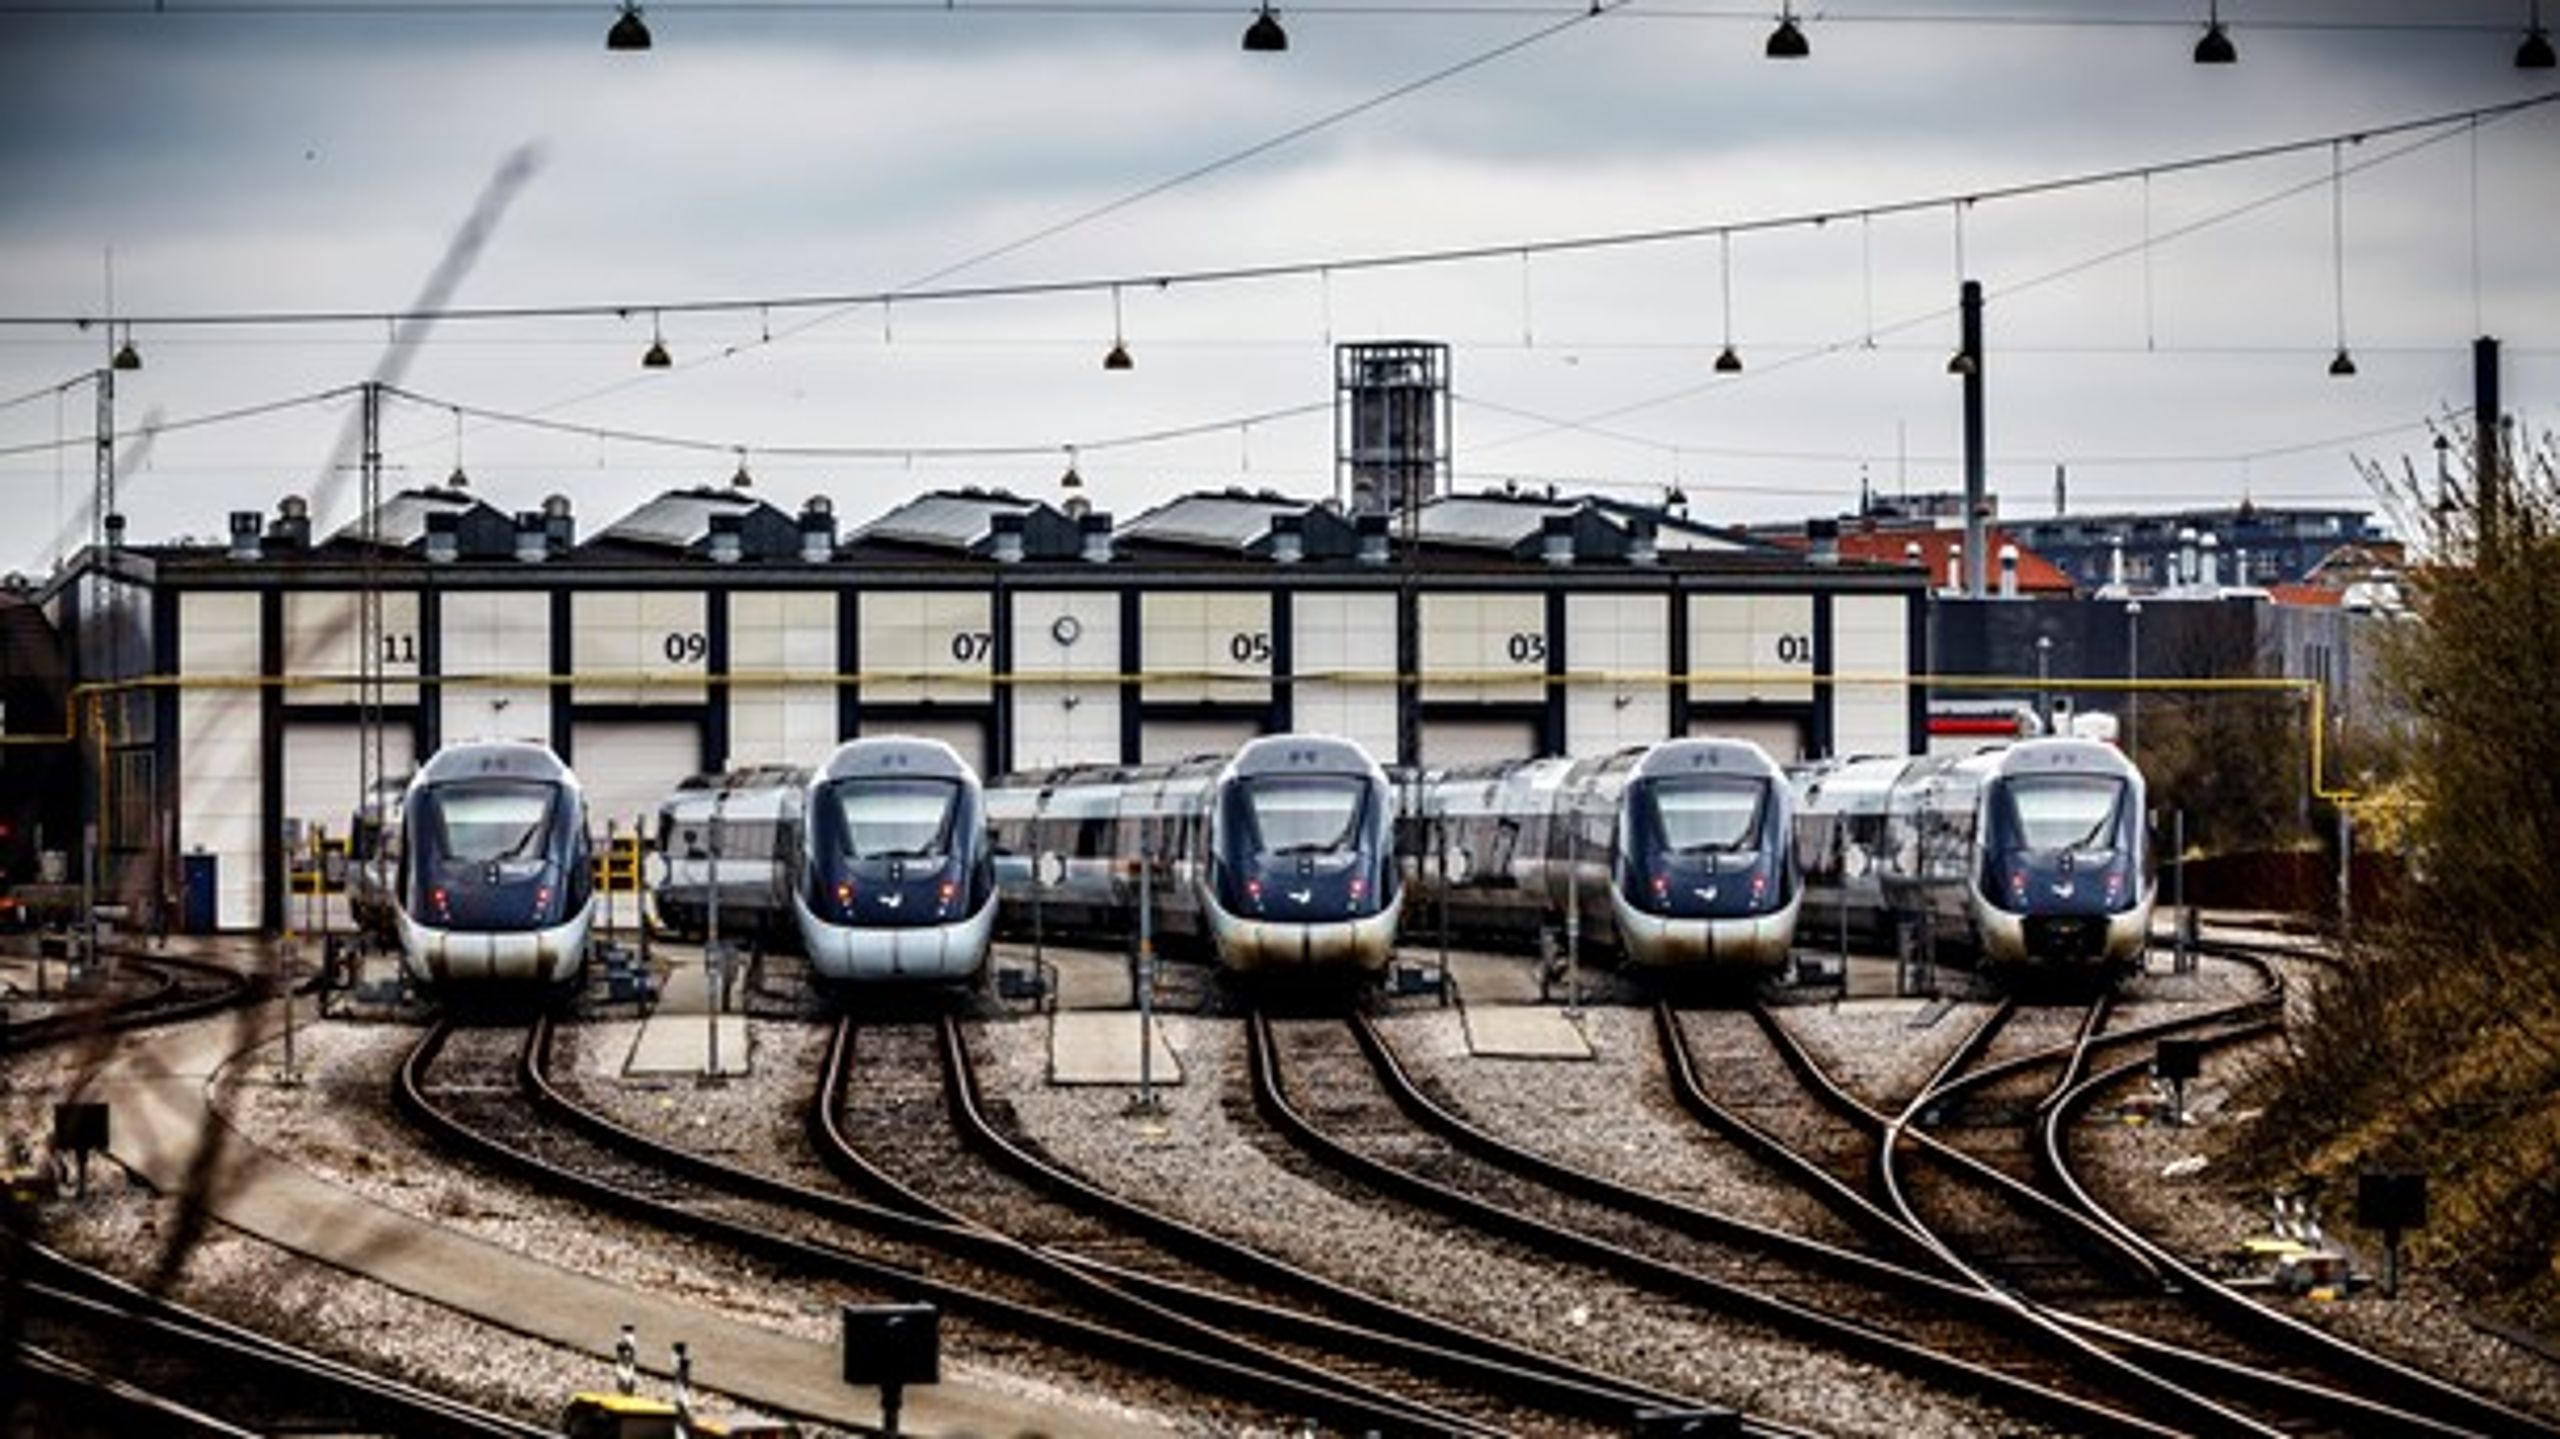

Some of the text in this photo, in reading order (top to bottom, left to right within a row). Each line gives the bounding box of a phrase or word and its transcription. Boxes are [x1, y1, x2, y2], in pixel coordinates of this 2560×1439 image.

[384, 634, 418, 663] 11
[665, 633, 706, 662] 09
[952, 633, 993, 662] 07
[1231, 633, 1272, 663] 05
[1508, 634, 1547, 663] 03
[1777, 634, 1813, 663] 01
